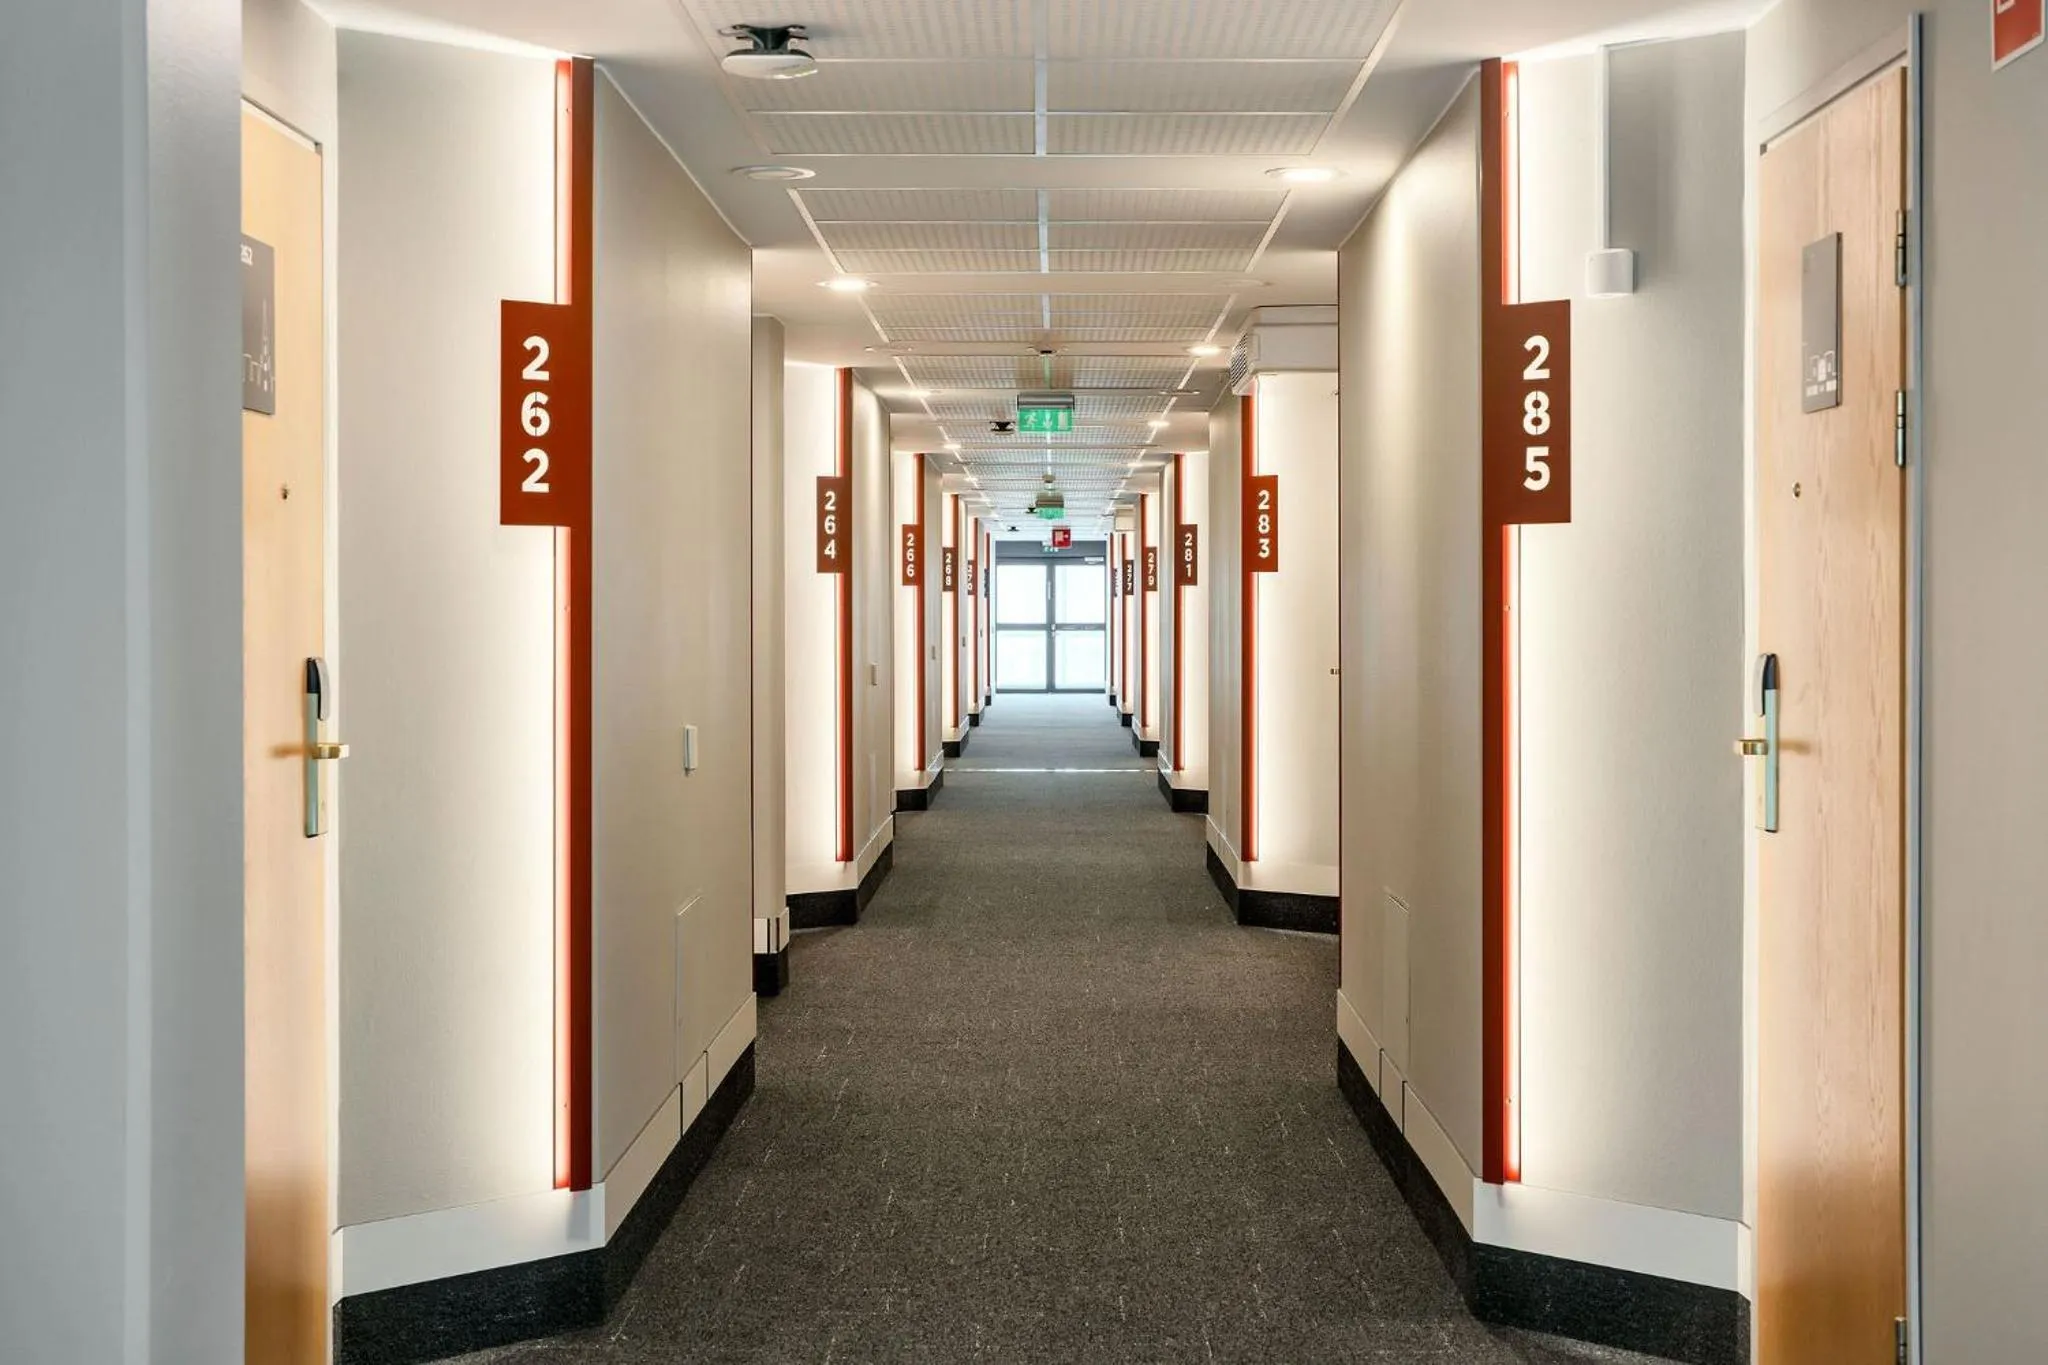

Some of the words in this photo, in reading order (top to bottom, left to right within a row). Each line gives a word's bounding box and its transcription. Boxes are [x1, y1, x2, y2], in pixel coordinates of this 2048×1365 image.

[521, 335, 551, 493] 262
[1523, 335, 1551, 491] 285
[824, 491, 836, 559] 264
[906, 533, 915, 577] 266
[1184, 533, 1193, 577] 281
[1258, 490, 1270, 558] 283
[1147, 552, 1155, 586] 279
